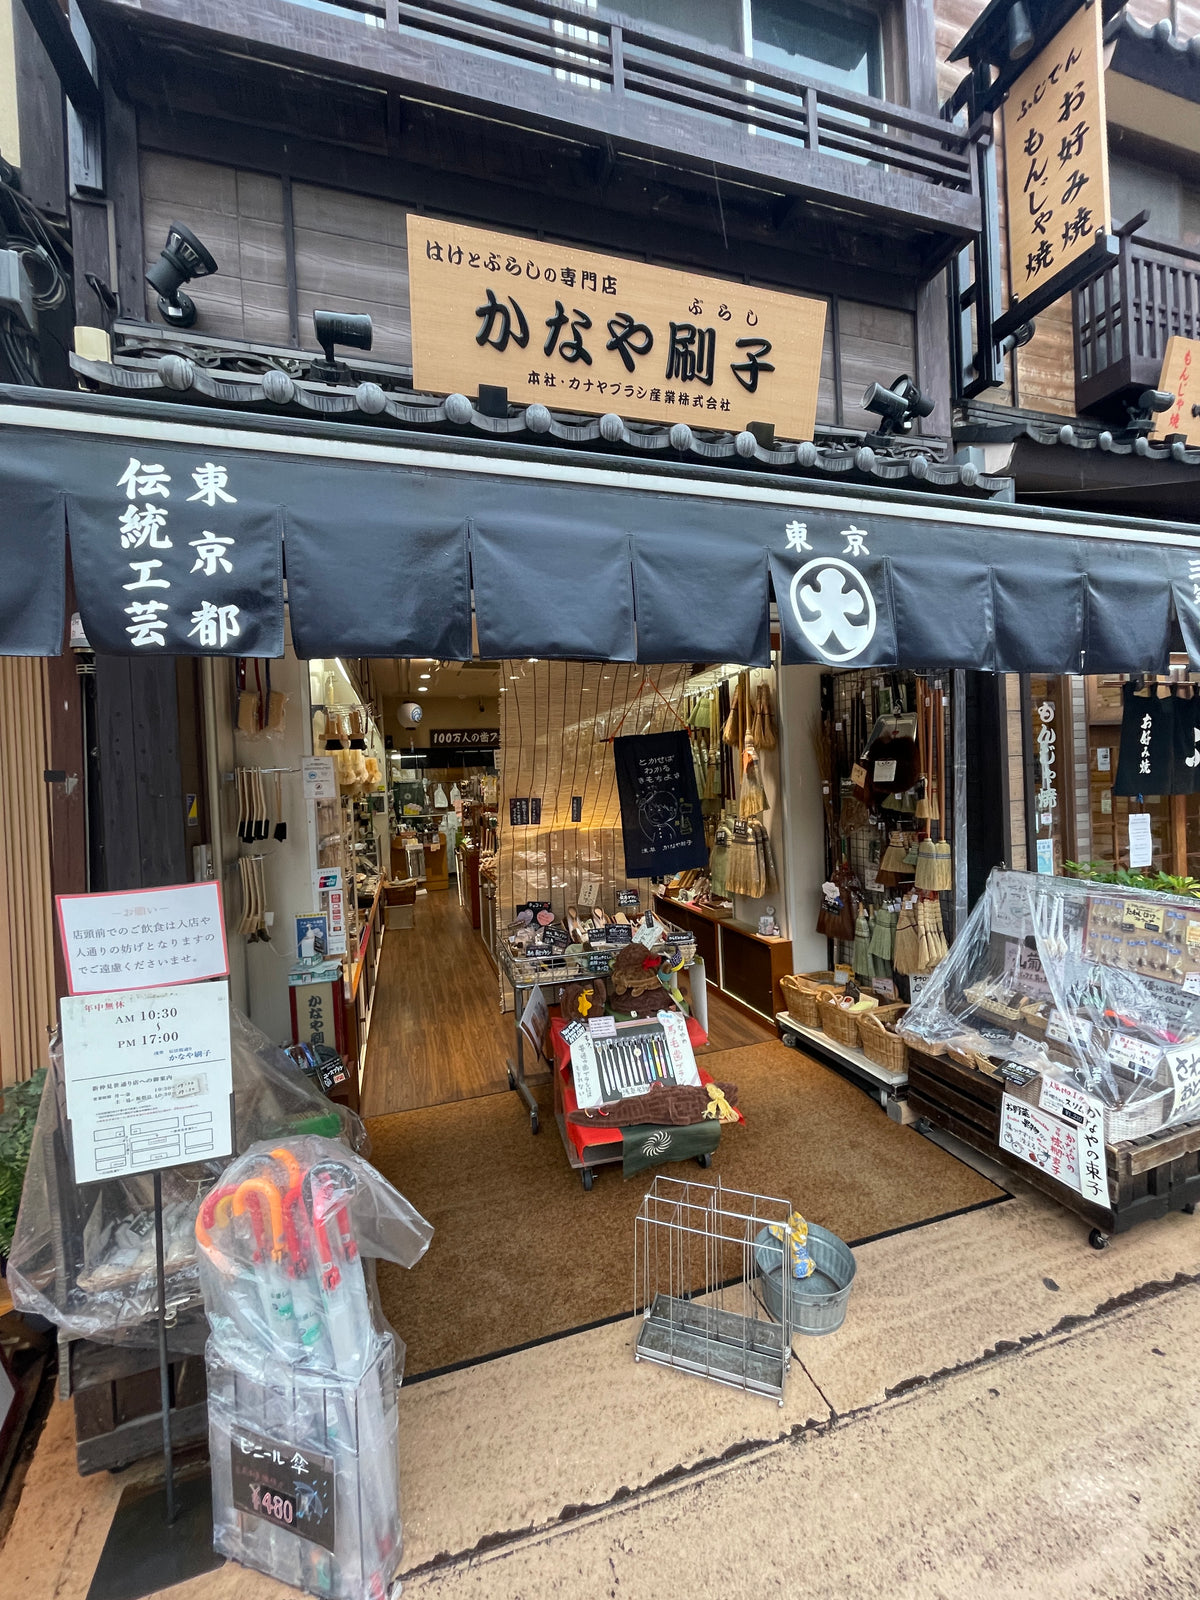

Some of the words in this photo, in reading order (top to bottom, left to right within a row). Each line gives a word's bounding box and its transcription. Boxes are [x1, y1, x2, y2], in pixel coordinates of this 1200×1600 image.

[1057, 80, 1094, 251] お好み焼
[1023, 128, 1055, 282] もんじゃ焼
[425, 239, 618, 295] はけとぶらしの専門店
[687, 297, 759, 327] ぶらし
[474, 287, 777, 393] かなや刷子
[527, 369, 732, 412] 本社・カナヤブラシ産業株式会社
[116, 457, 173, 648] 伝統工芸
[185, 462, 241, 649] 東京都
[784, 520, 871, 557] 東京
[1139, 713, 1152, 774] お好み焼
[72, 916, 211, 940] 店頭前でのご飲食は入店や
[75, 932, 215, 958] 人通りの妨げとなりますの
[78, 954, 197, 975] でご遠慮くださいませ。
[115, 1014, 135, 1025] AM
[140, 1007, 178, 1021] 10:30
[118, 1039, 136, 1049] PM
[142, 1031, 179, 1045] 17:00
